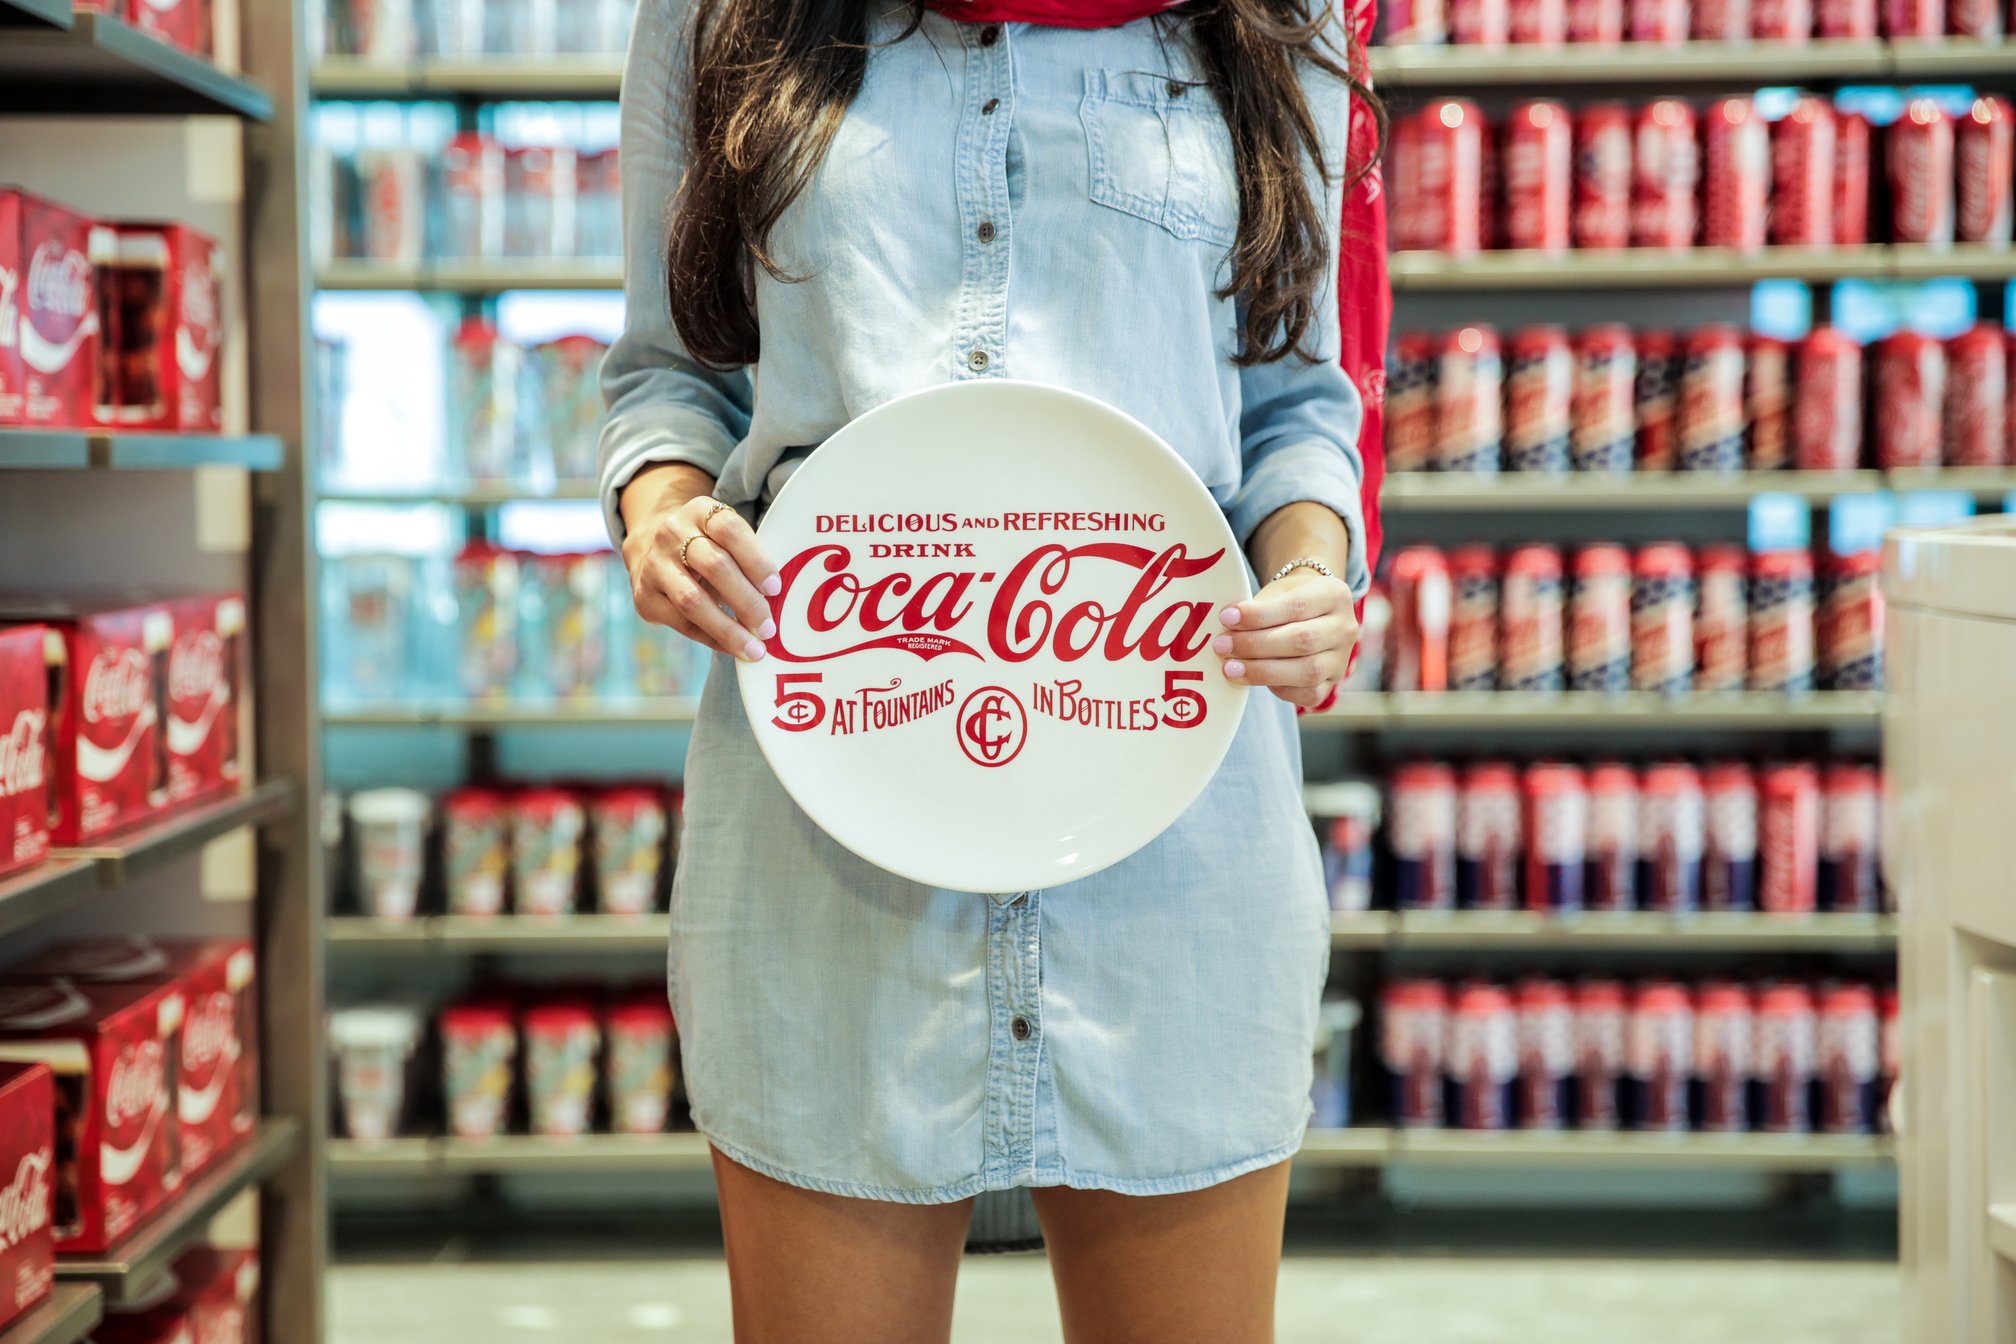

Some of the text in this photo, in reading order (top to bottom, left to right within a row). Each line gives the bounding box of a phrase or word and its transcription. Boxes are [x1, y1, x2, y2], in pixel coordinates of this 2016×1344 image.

[815, 512, 1165, 533] DELICIOUS AND REFRESHING
[869, 543, 976, 558] DRINK
[764, 543, 1226, 663] Coca-Cola
[907, 643, 943, 651] REGISTERED
[927, 638, 951, 647] MARK
[1033, 683, 1054, 717] IN
[830, 698, 858, 736] AT
